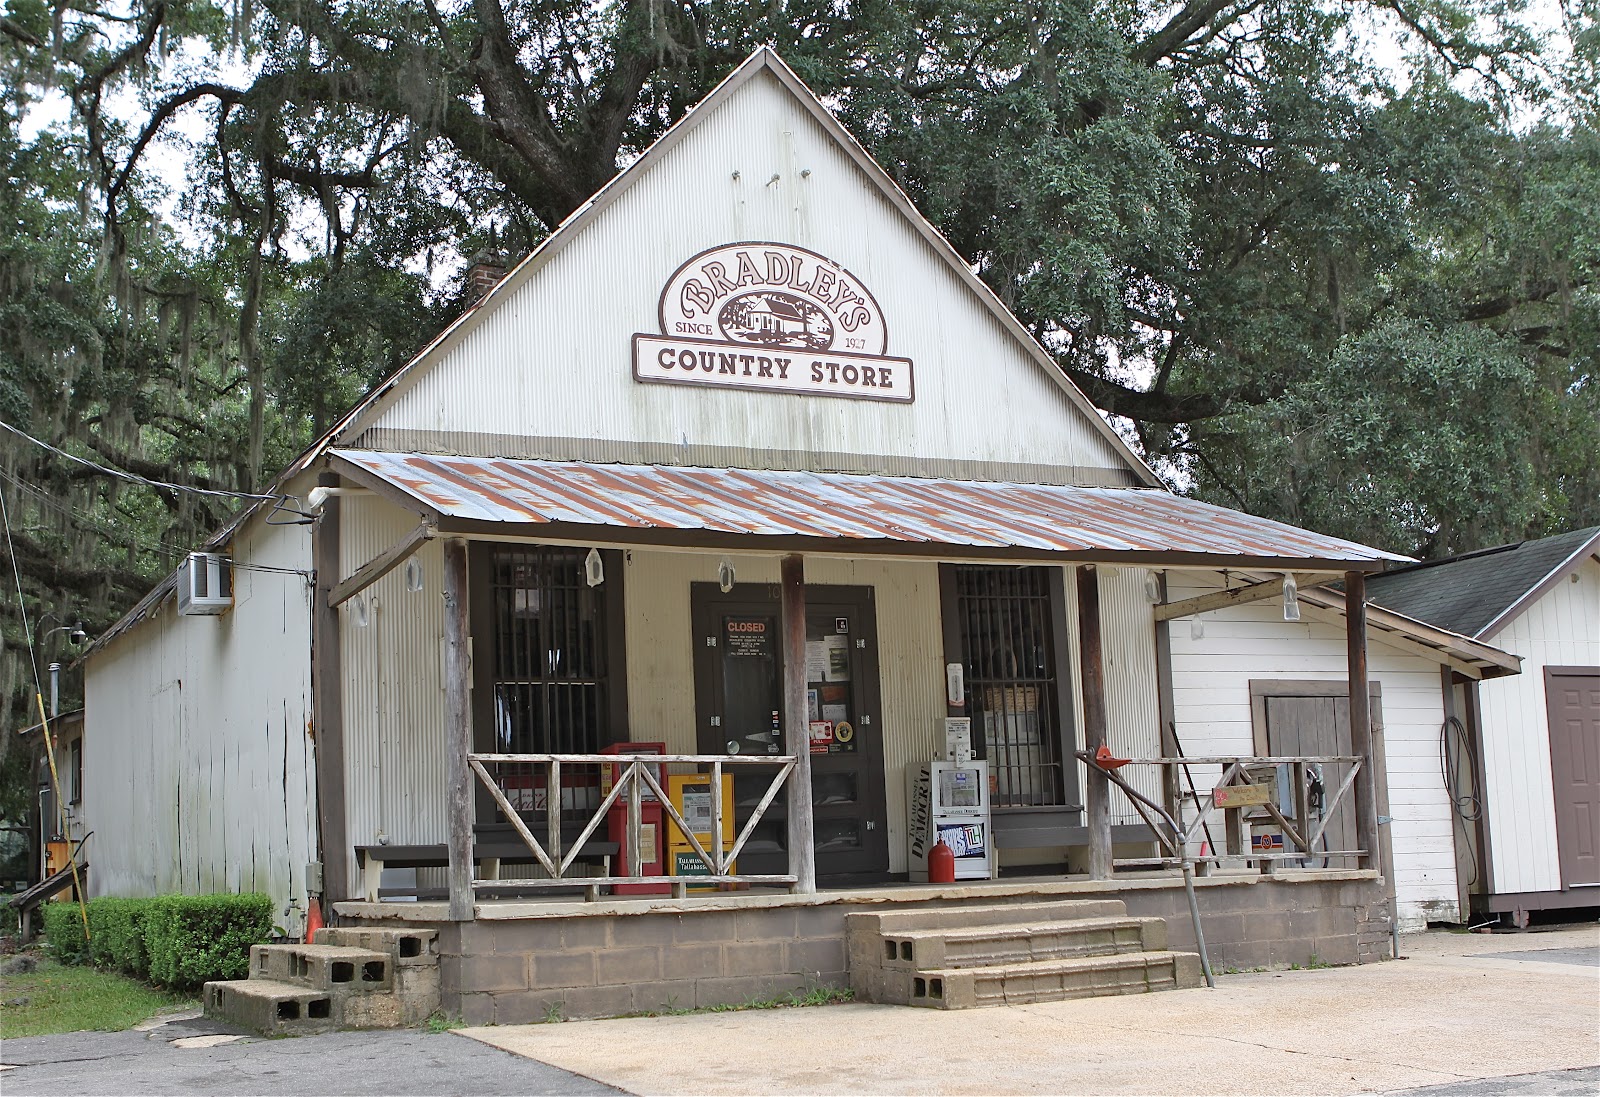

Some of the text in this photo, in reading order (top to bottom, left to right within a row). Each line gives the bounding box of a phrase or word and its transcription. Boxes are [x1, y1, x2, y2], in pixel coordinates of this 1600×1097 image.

[680, 251, 871, 332] BRADLEY'S
[675, 321, 713, 336] SINCE
[845, 338, 866, 350] 1927
[657, 348, 894, 388] COUNTRY STORE
[727, 622, 766, 632] CLOSED
[912, 766, 930, 859] DEMOCRAT
